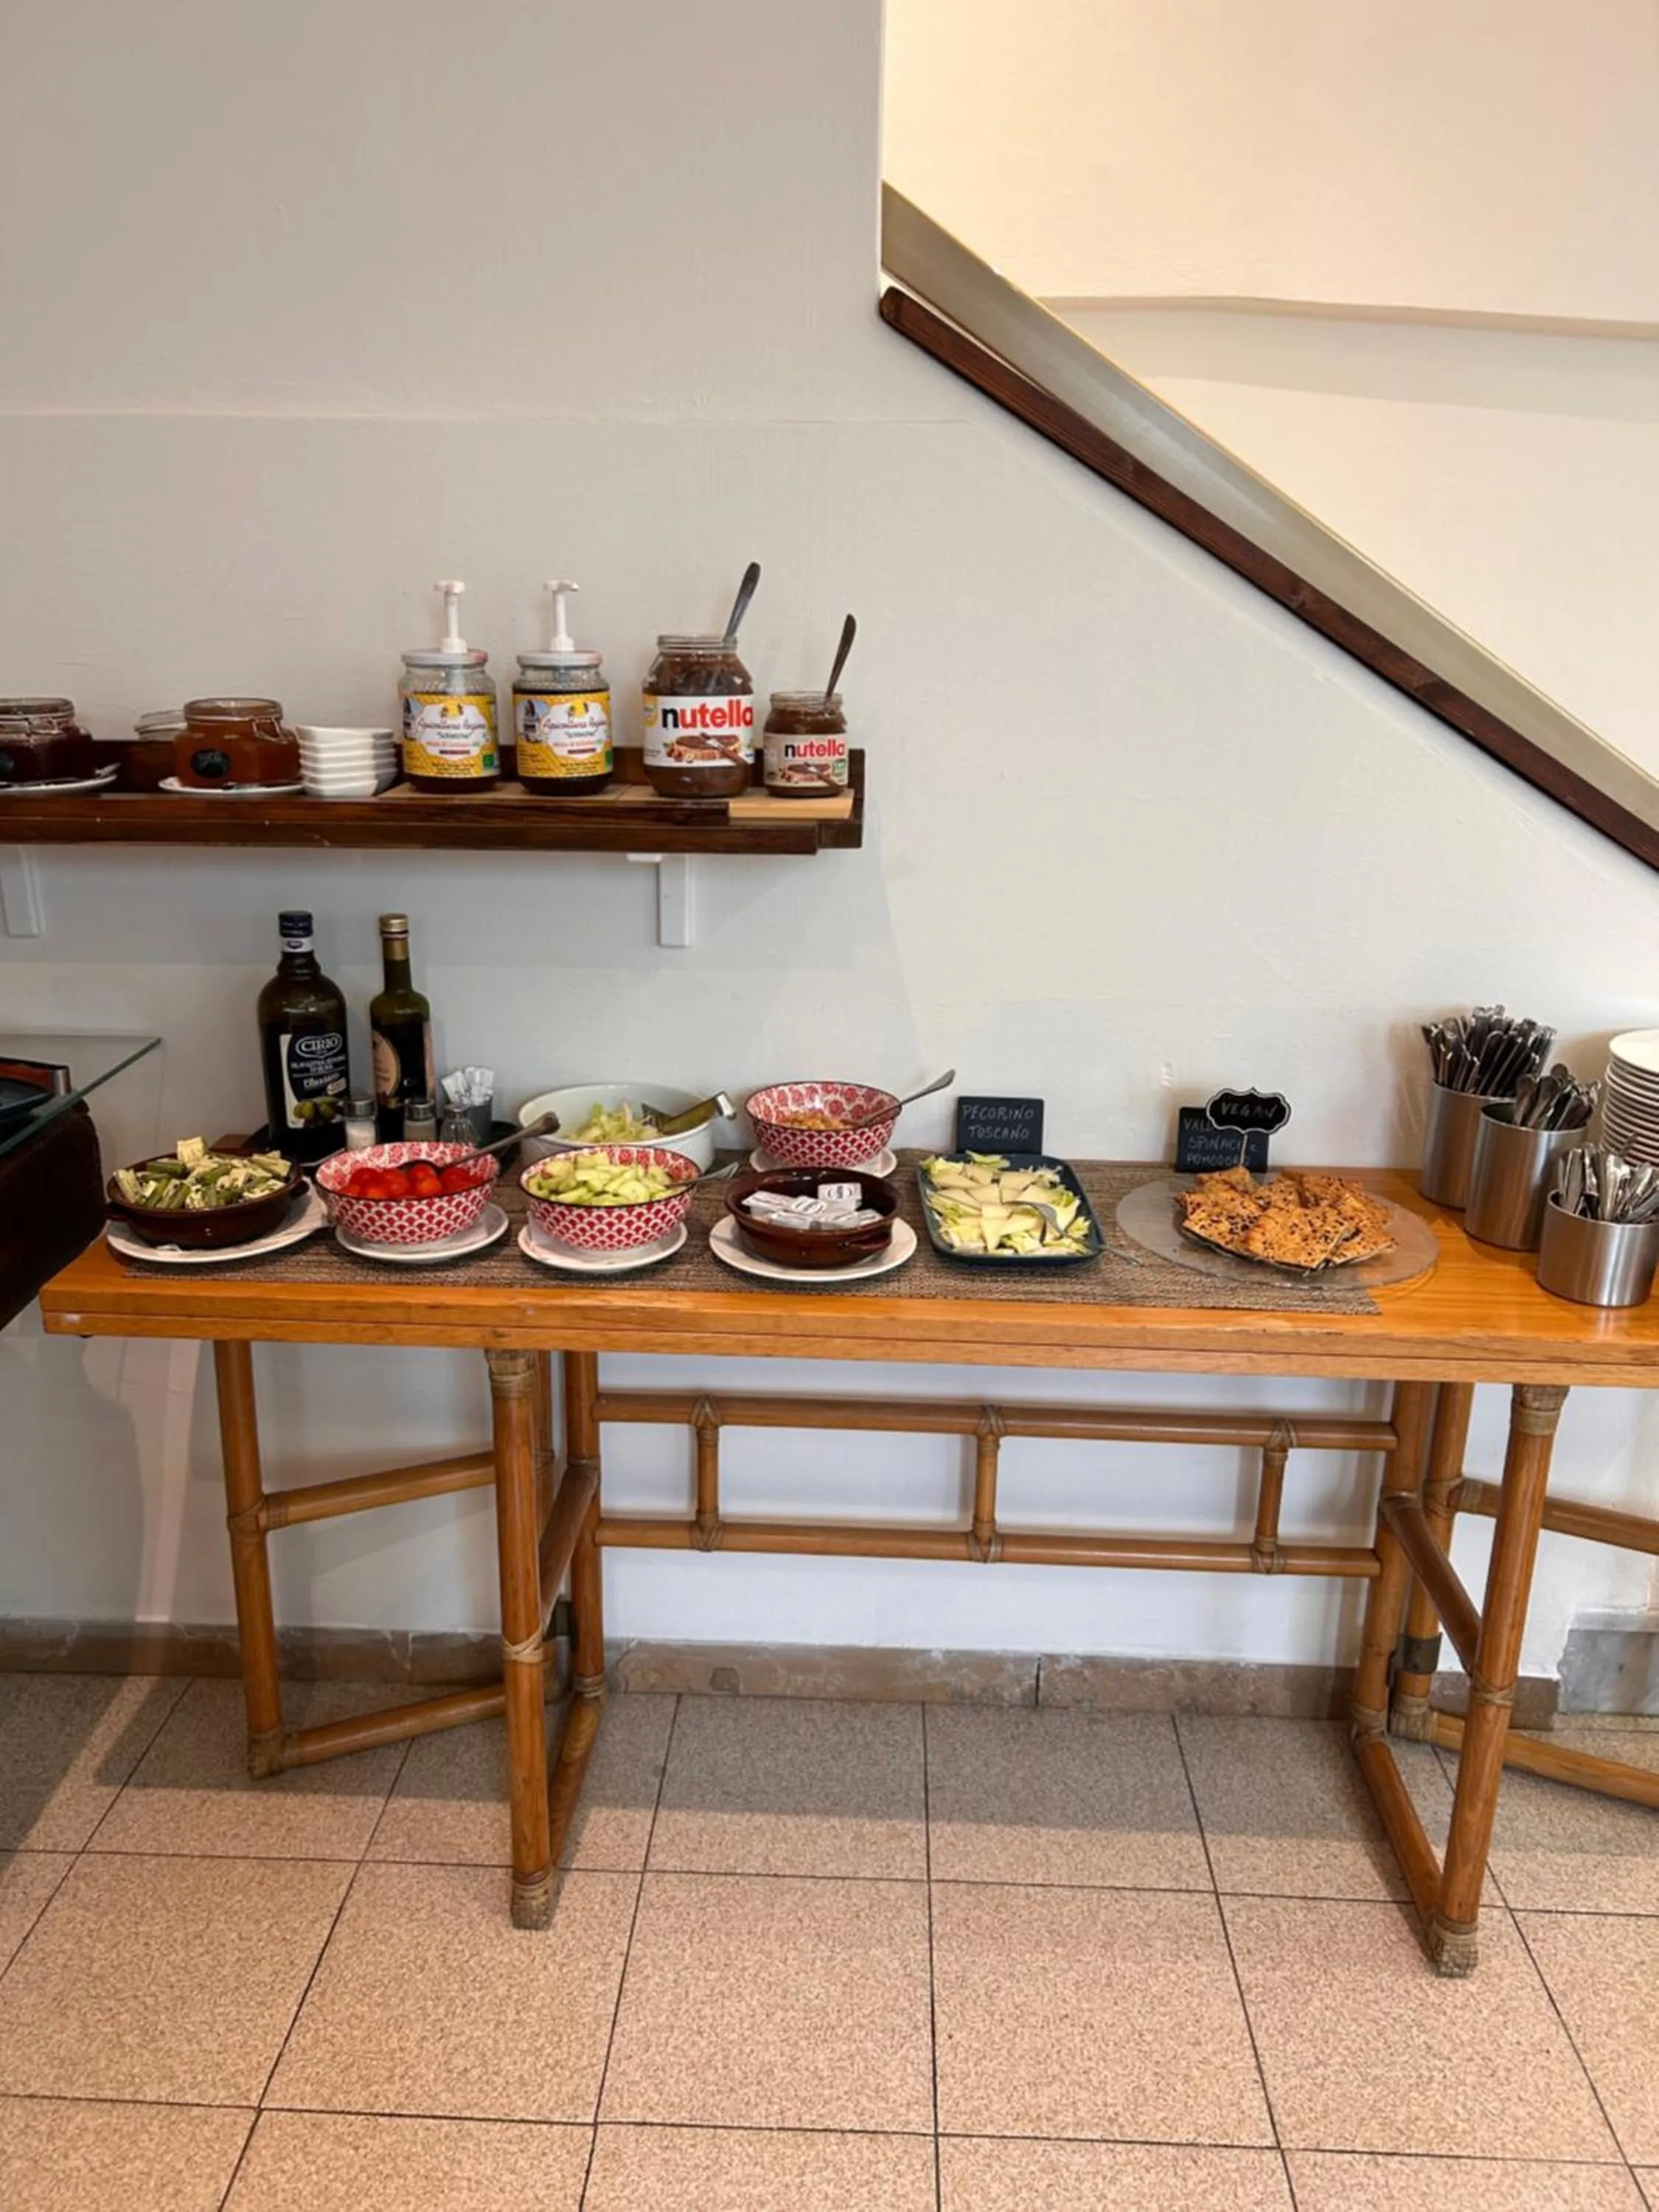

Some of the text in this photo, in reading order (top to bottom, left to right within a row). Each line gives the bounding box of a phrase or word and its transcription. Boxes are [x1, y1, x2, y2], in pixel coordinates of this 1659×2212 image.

[661, 699, 754, 728] nutella
[785, 740, 846, 757] nutella
[301, 1037, 338, 1052] CIRIO
[962, 1104, 1034, 1121] PECORINO
[1221, 1102, 1279, 1119] VEGAN
[967, 1123, 1030, 1140] TOSCANO
